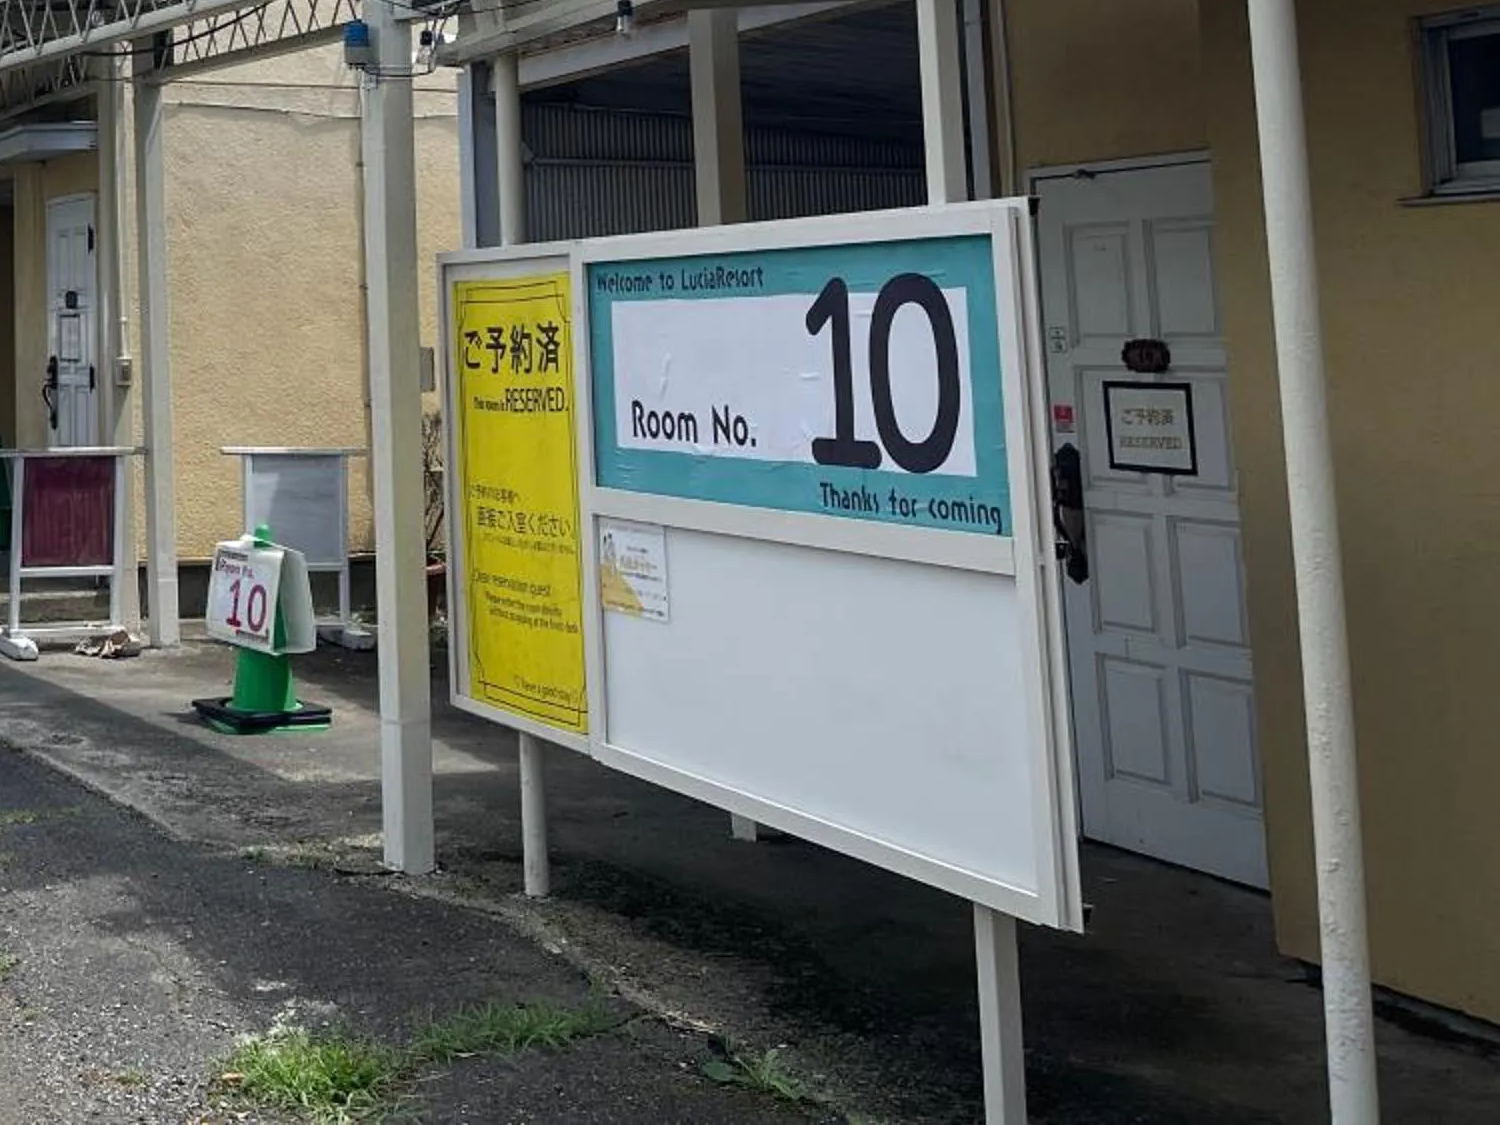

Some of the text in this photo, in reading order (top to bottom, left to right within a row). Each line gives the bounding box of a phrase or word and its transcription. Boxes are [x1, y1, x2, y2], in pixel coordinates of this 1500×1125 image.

[597, 266, 764, 294] Welcome to LuciaResort
[463, 320, 560, 374] ご予約済
[805, 272, 962, 474] 10
[631, 399, 757, 448] Room No.
[819, 481, 879, 514] Thanks
[928, 495, 1003, 535] coming
[226, 578, 267, 632] 10
